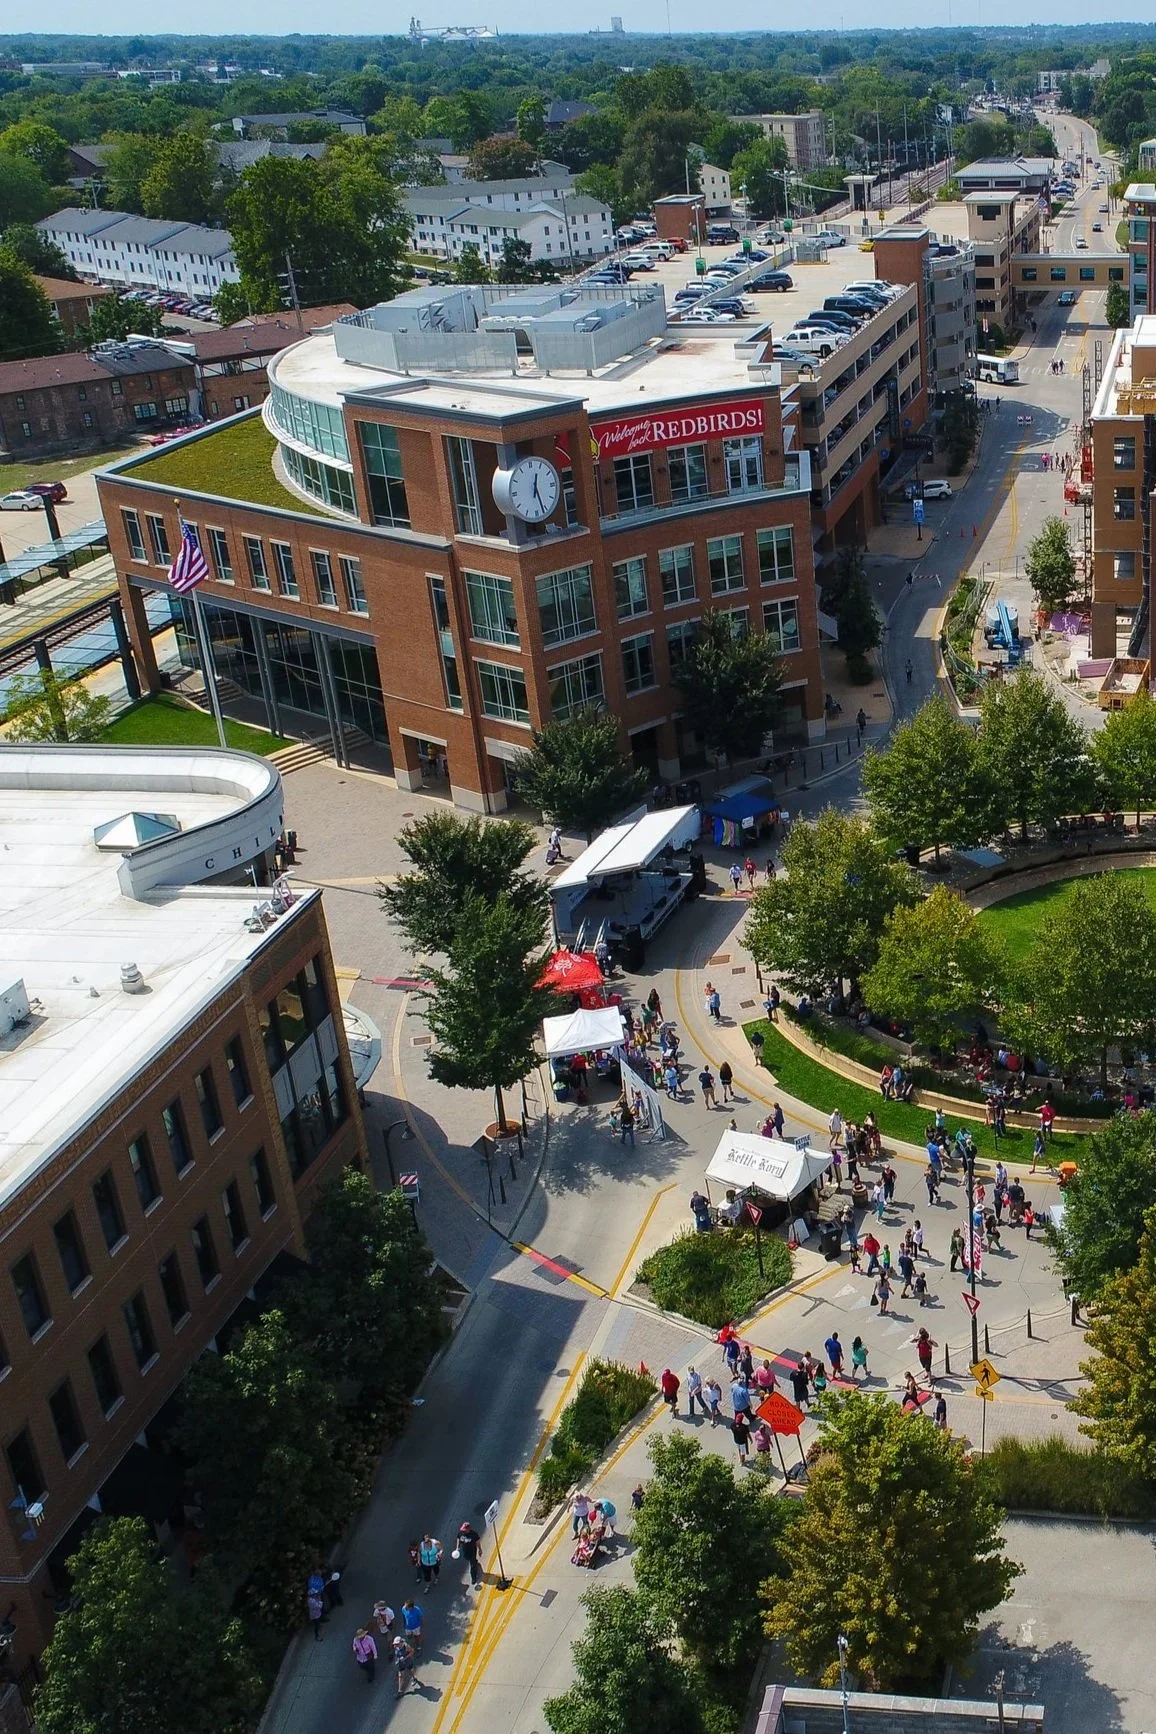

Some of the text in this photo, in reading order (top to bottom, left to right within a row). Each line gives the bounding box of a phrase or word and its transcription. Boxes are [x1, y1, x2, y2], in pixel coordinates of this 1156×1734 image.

[600, 420, 650, 448] Welcome
[652, 409, 763, 442] REDBIRDS!
[628, 431, 651, 451] back
[205, 815, 283, 869] CHIL
[727, 1148, 783, 1177] Kettle Korn
[767, 1409, 796, 1418] CLOSED
[770, 1400, 790, 1409] ROAD
